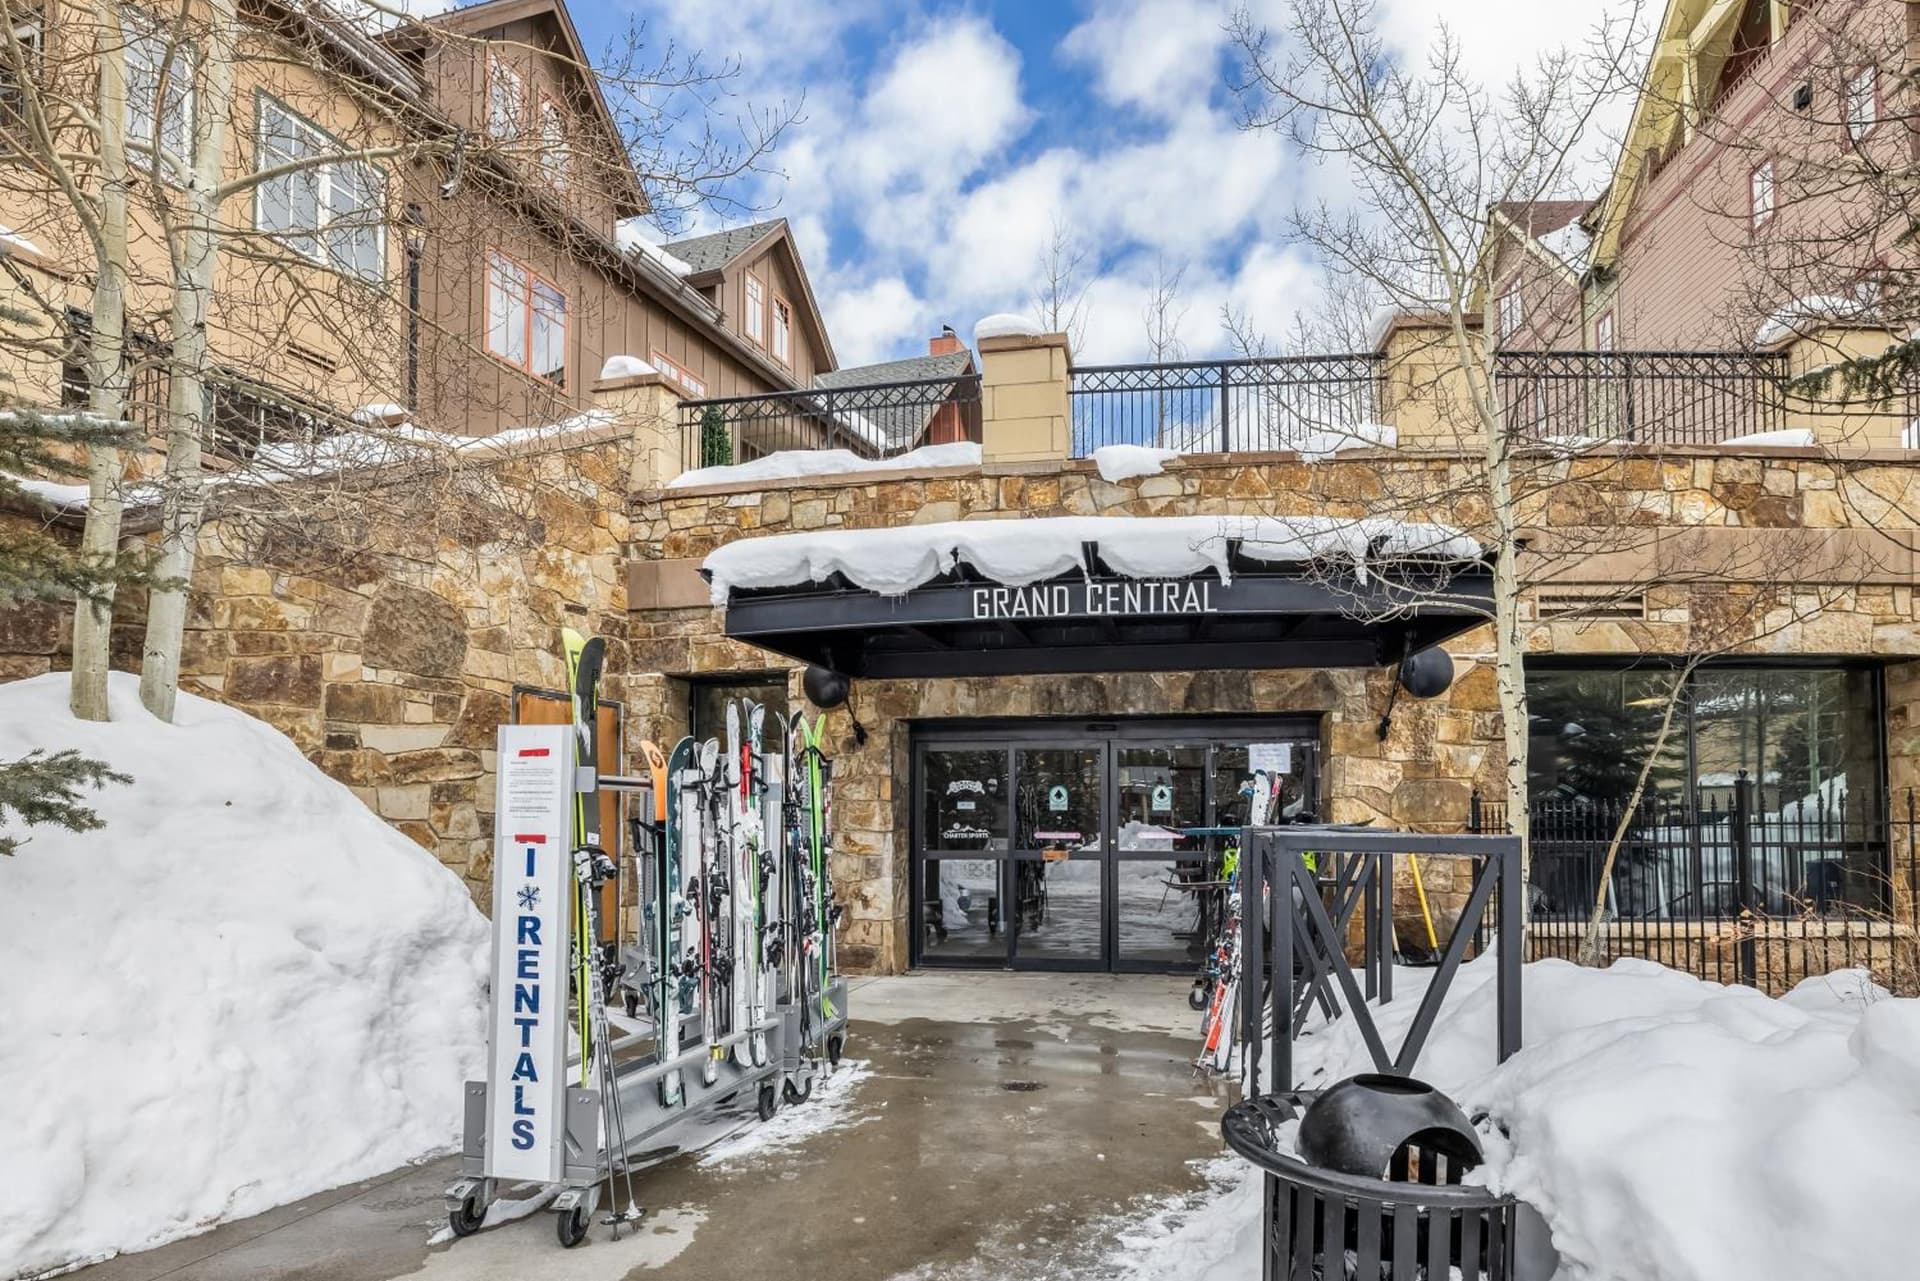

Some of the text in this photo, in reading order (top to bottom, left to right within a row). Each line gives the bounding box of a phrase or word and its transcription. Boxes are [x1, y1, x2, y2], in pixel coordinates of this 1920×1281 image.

[973, 582, 1219, 619] GRAND CENTRAL
[511, 915, 543, 1150] RENTALS
